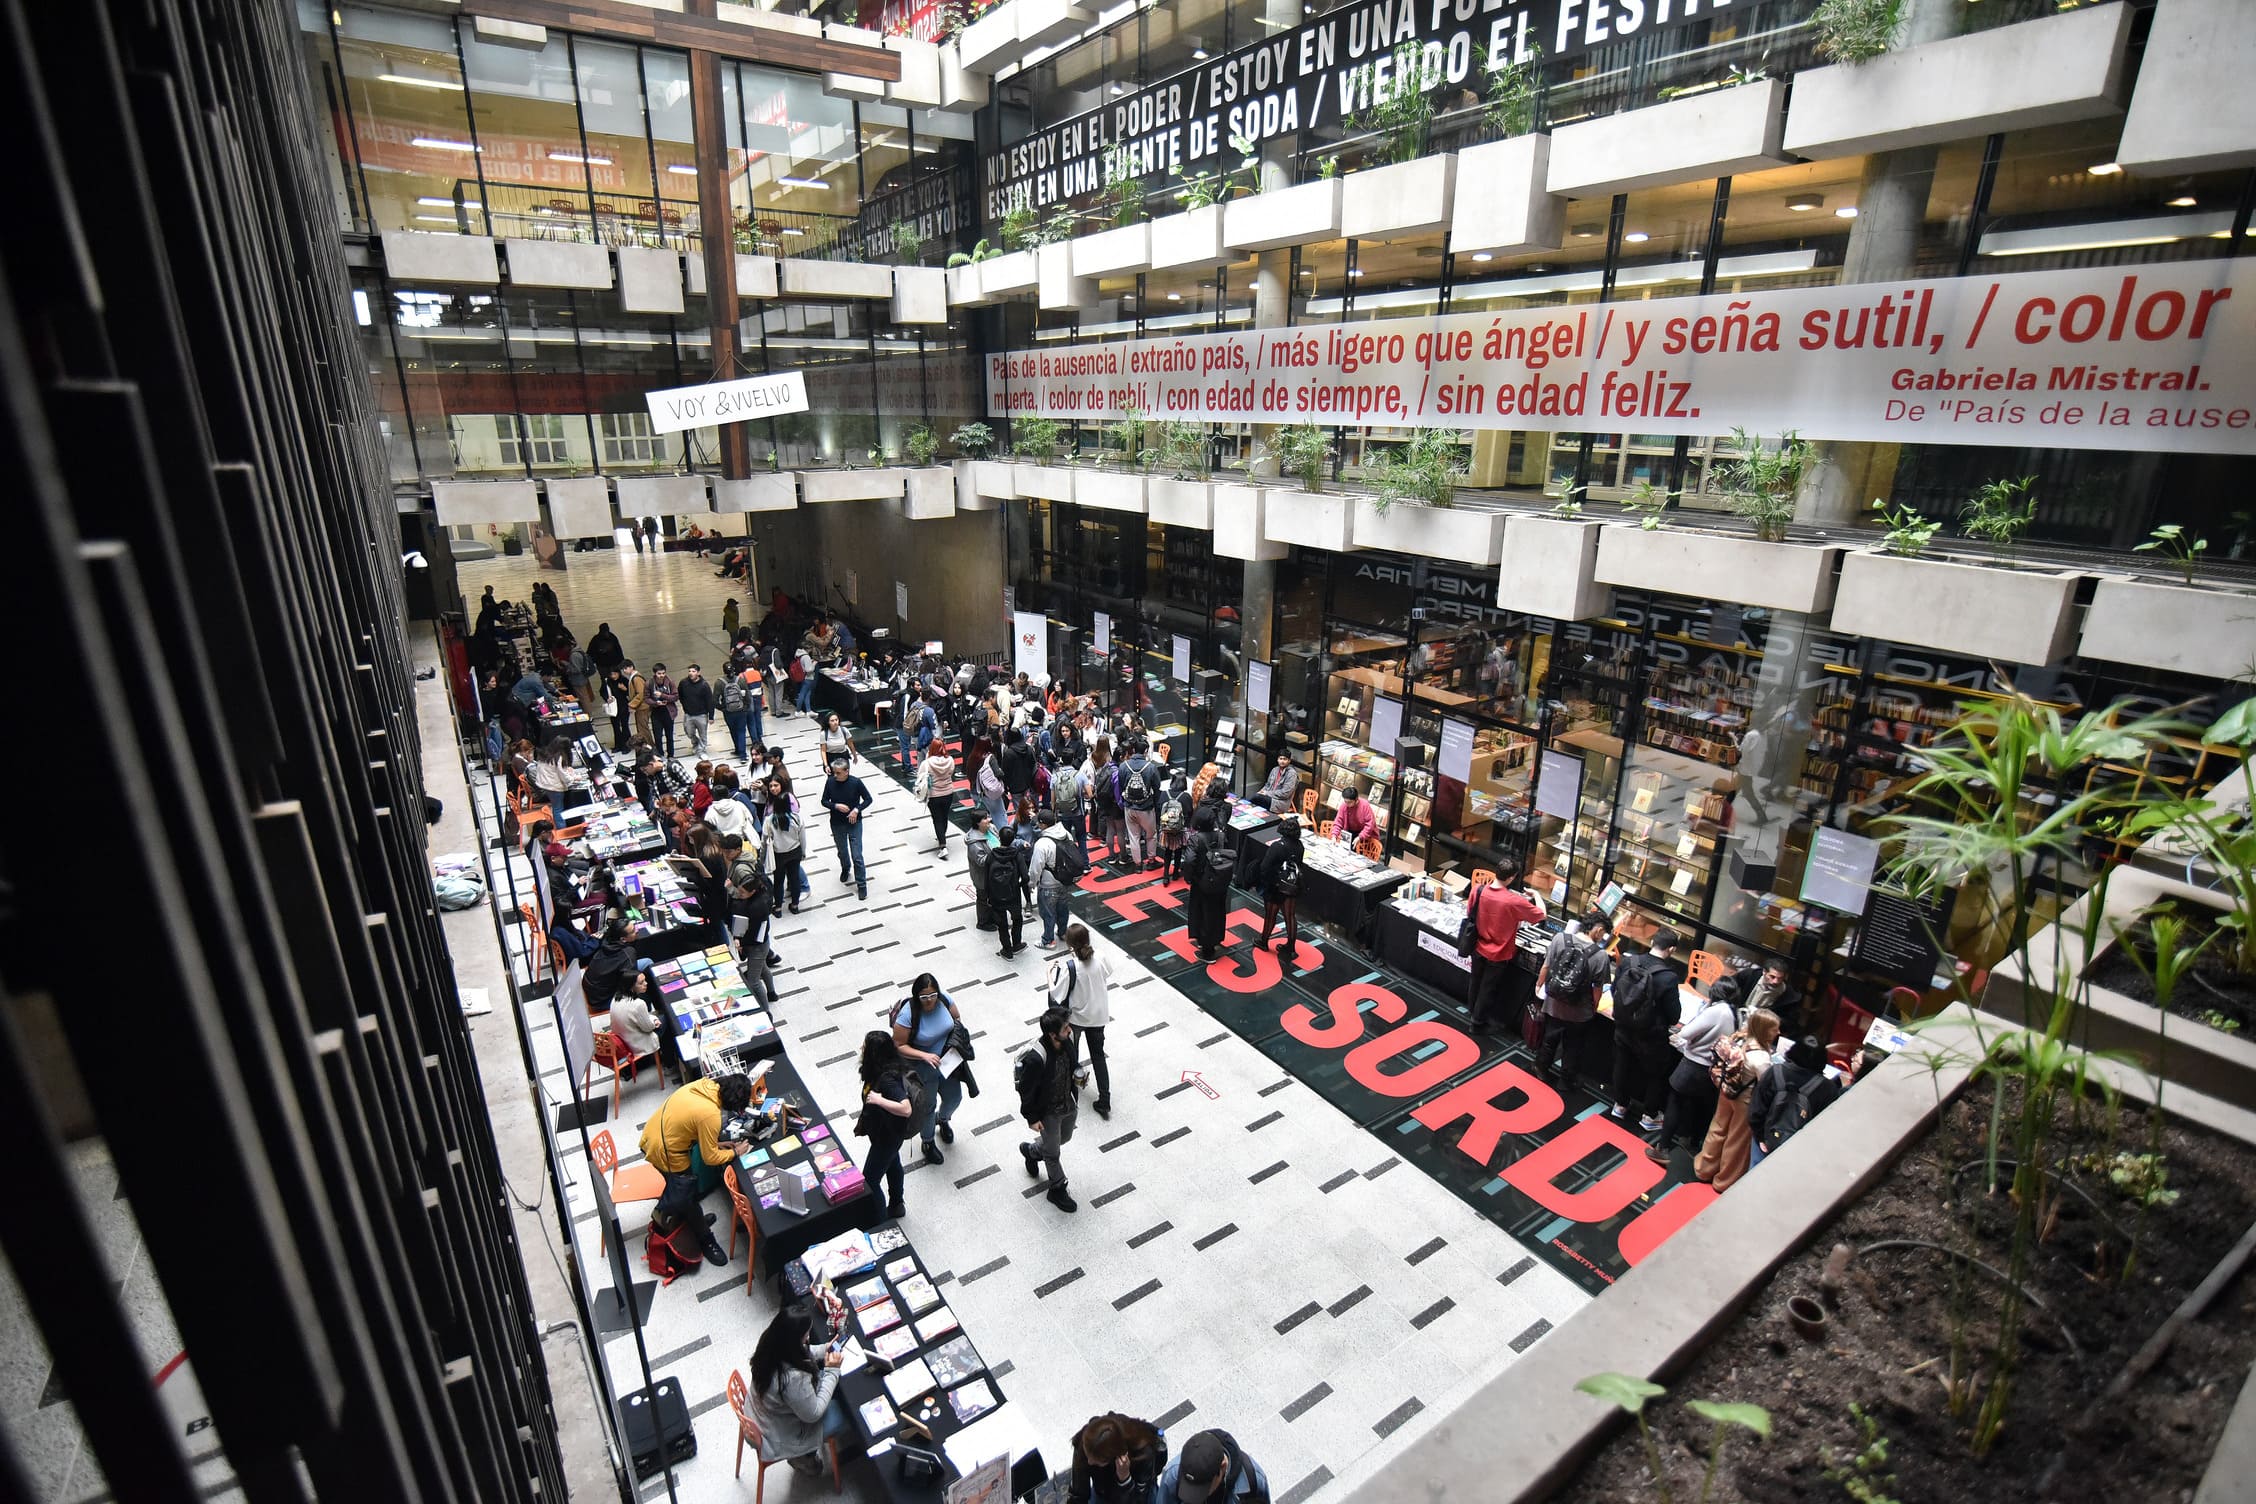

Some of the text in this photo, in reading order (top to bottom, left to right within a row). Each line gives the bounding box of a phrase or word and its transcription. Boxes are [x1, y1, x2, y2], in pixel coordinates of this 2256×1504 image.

[987, 154, 1006, 187] NO
[1010, 132, 1058, 178] ESTOY
[1061, 121, 1083, 161] EN
[1088, 112, 1109, 152] EL
[1114, 83, 1182, 143] PODER
[1209, 38, 1290, 109] ESTOY
[1299, 20, 1337, 77] EN
[1348, 0, 1416, 59] UNA
[987, 177, 1033, 221] ESTOY
[1037, 166, 1058, 207] EN
[1063, 156, 1099, 199] UNA
[1103, 127, 1182, 186] FUENTE
[1188, 112, 1219, 161] DE
[1227, 86, 1298, 150] SODA
[1487, 10, 1534, 73] EL
[992, 353, 1019, 379] País
[1022, 353, 1036, 378] de
[1039, 352, 1051, 378] la
[1054, 346, 1117, 377] ausencia
[1130, 340, 1197, 373] extraño
[1202, 336, 1251, 377] país,
[1270, 332, 1320, 367] más
[1327, 327, 1405, 374] ligero
[1414, 331, 1473, 372] que
[1482, 311, 1589, 369] ángel
[1621, 319, 1652, 367] y
[1663, 300, 1781, 355] seña
[1799, 288, 1945, 356] sutil,
[2014, 274, 2233, 345] color
[993, 387, 1038, 412] muerta,
[1049, 383, 1083, 410] color
[1087, 383, 1105, 410] de
[1167, 387, 1200, 411] con
[1205, 379, 1255, 412] edad
[1261, 378, 1292, 412] de
[1296, 379, 1408, 420] siempre,
[1437, 373, 1485, 416] sin
[1496, 370, 1590, 417] edad
[1600, 369, 1702, 418] feliz.
[1891, 365, 2211, 391] Gabriela Mistral.
[667, 395, 706, 420] VOY
[1885, 399, 2256, 430] De "País de la ause
